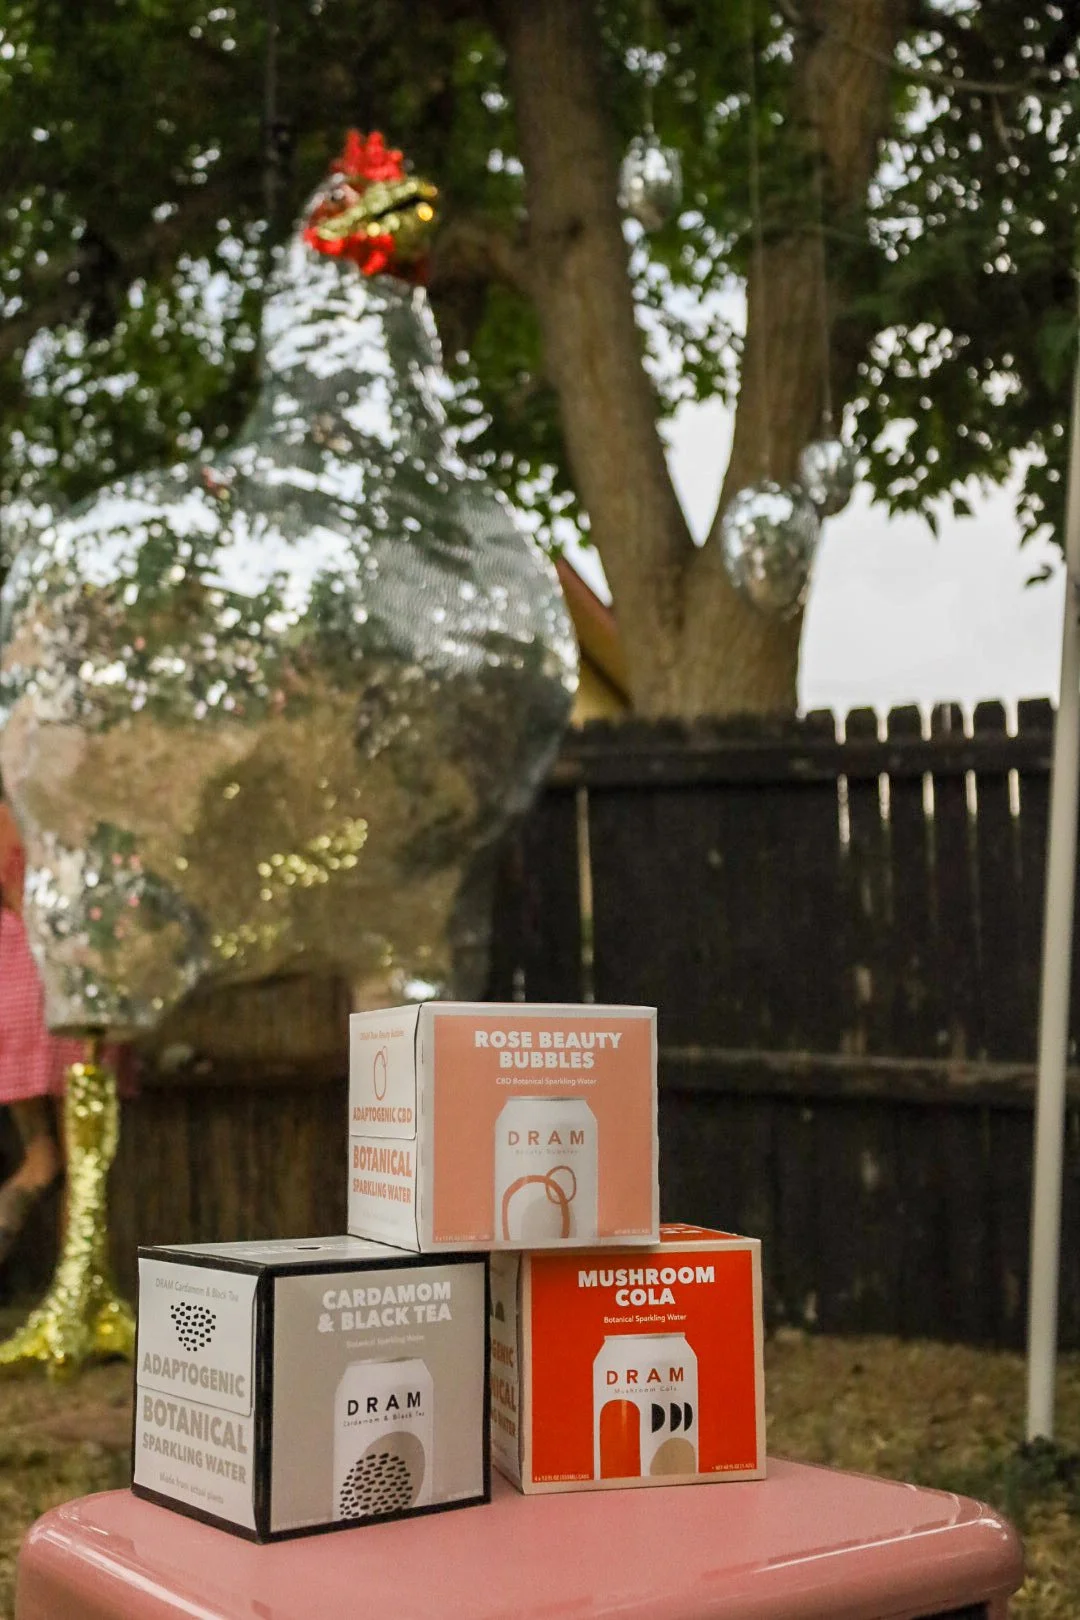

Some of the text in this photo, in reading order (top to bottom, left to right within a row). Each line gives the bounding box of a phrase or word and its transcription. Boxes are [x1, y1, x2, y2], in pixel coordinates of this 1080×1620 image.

[474, 1030, 623, 1049] ROSE BEAUTY
[499, 1051, 595, 1068] BUBBLES
[495, 1076, 598, 1087] CBD Botanical Sparkling Water
[352, 1106, 413, 1124] ADAPTOGENIC CBD
[508, 1130, 585, 1146] DRAM
[353, 1145, 413, 1178] BOTANICAL
[352, 1178, 412, 1204] SPARKLING WATER
[578, 1266, 715, 1288] MUSHROOM
[322, 1281, 451, 1310] CARDAMOM
[615, 1288, 676, 1307] COLA
[317, 1303, 453, 1333] & BLACK TEA
[603, 1312, 687, 1324] Botanical Sparkling Water
[142, 1352, 246, 1398] ADAPTOGENIC
[606, 1366, 685, 1386] DRAM
[347, 1391, 421, 1416] DRAM
[142, 1394, 248, 1454] BOTANICAL
[142, 1432, 247, 1485] SPARKLING WATER
